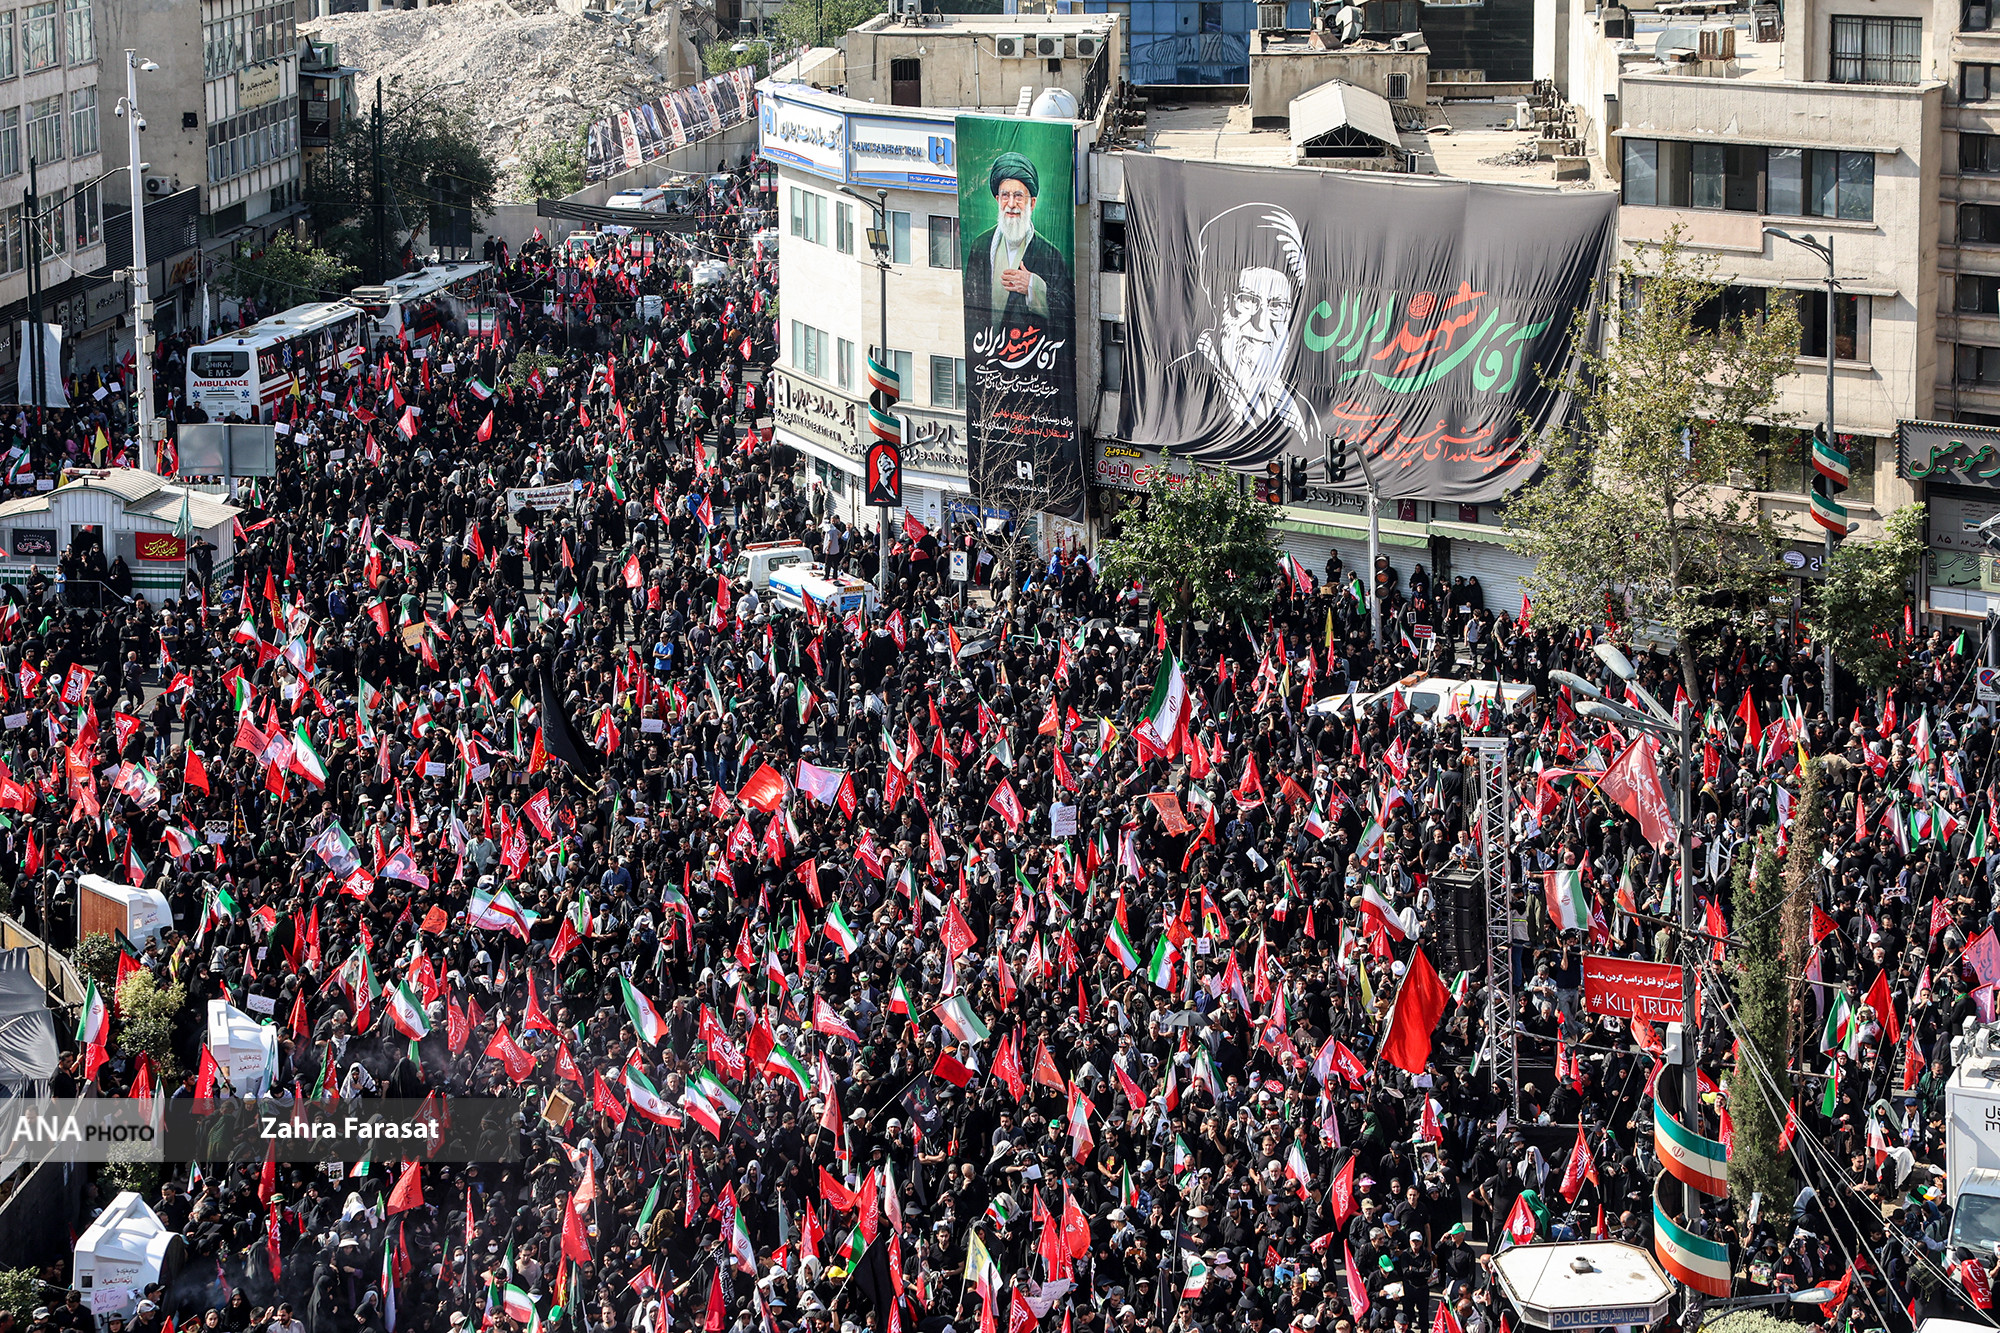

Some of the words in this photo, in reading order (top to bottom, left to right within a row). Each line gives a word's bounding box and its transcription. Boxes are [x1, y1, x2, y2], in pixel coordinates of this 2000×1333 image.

[851, 141, 871, 153] BANK
[872, 143, 903, 156] SADERAT
[904, 146, 922, 157] IRAN
[1371, 280, 1488, 374] شهید
[1303, 289, 1397, 383] ایران
[973, 326, 1006, 364] ایران
[998, 325, 1041, 361] شهید
[999, 334, 1066, 370] آقای
[1372, 306, 1554, 394] آقای
[205, 361, 233, 369] SHIRAZ
[1038, 412, 1060, 425] رسیدن
[1060, 416, 1074, 427] برای
[1009, 425, 1024, 434] ایران
[1042, 430, 1068, 439] استقلال
[920, 451, 947, 463] BANK
[1104, 446, 1142, 459] ساندویچ
[1097, 460, 1132, 485] جزیره
[1937, 534, 1952, 544] ۸۵
[1605, 974, 1623, 982] کردن
[1623, 976, 1643, 986] ترامپ
[1643, 975, 1657, 986] قتل
[1656, 978, 1664, 986] تو
[1664, 979, 1680, 989] خون
[1554, 1311, 1599, 1325] POLICE
